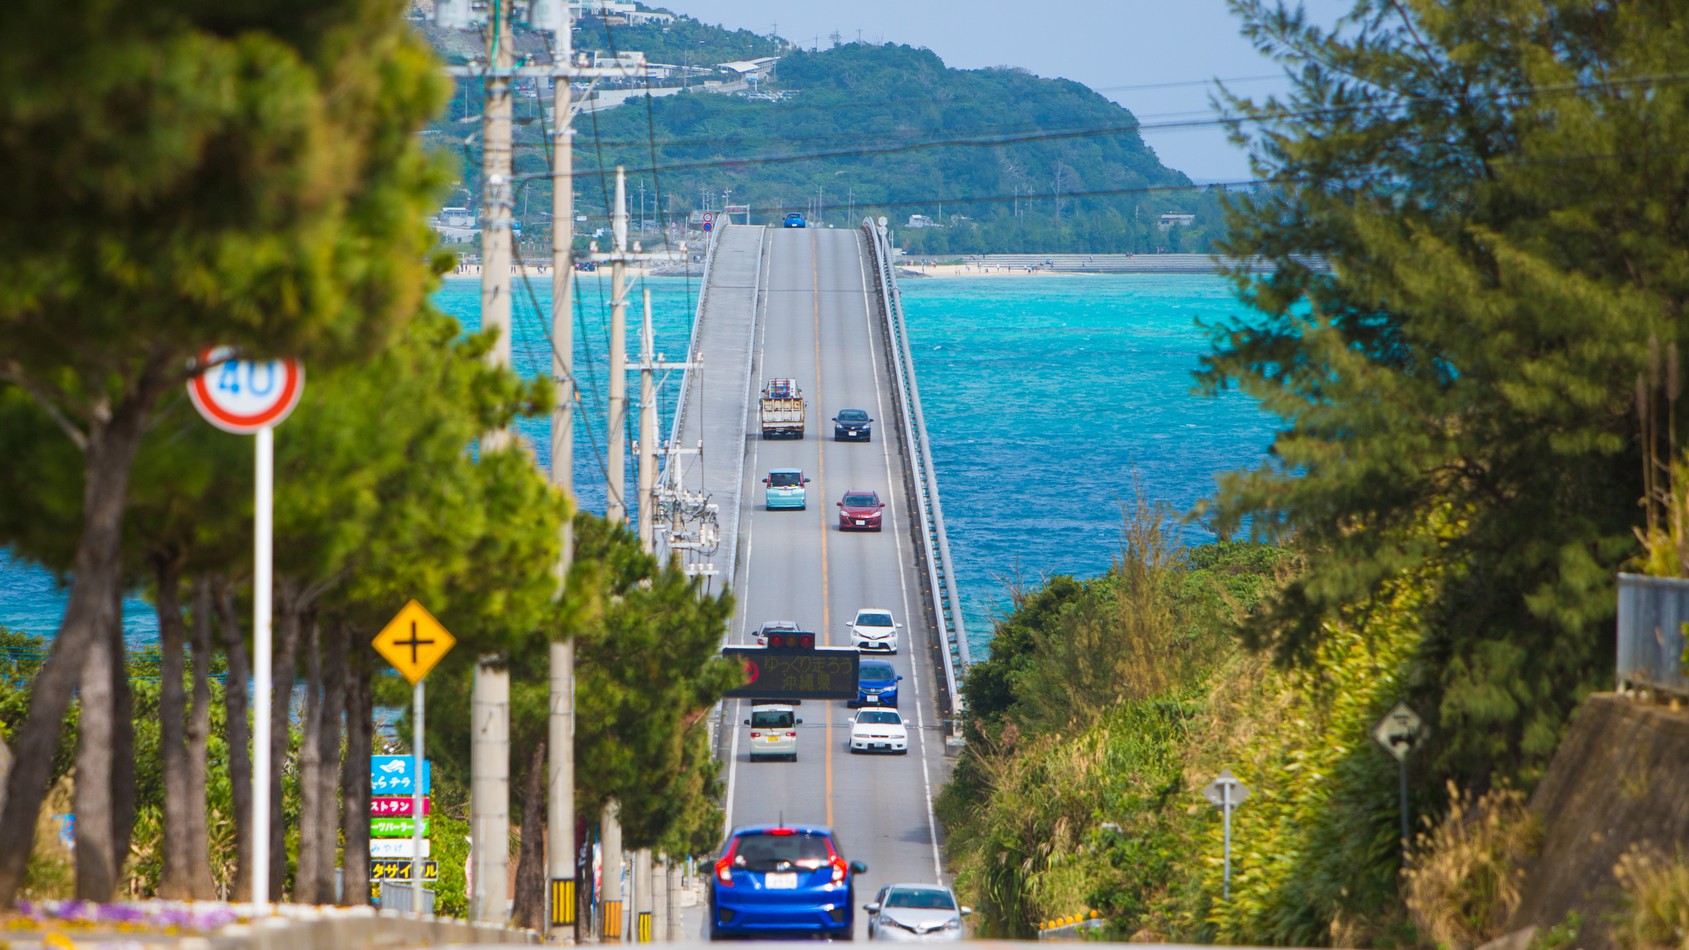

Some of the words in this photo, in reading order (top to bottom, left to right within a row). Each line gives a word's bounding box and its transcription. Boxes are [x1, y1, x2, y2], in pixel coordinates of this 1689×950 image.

[218, 359, 275, 397] 40
[763, 655, 853, 674] ゆっくり走ろう
[782, 672, 831, 691] 沖縄県
[372, 863, 438, 879] タサイル
